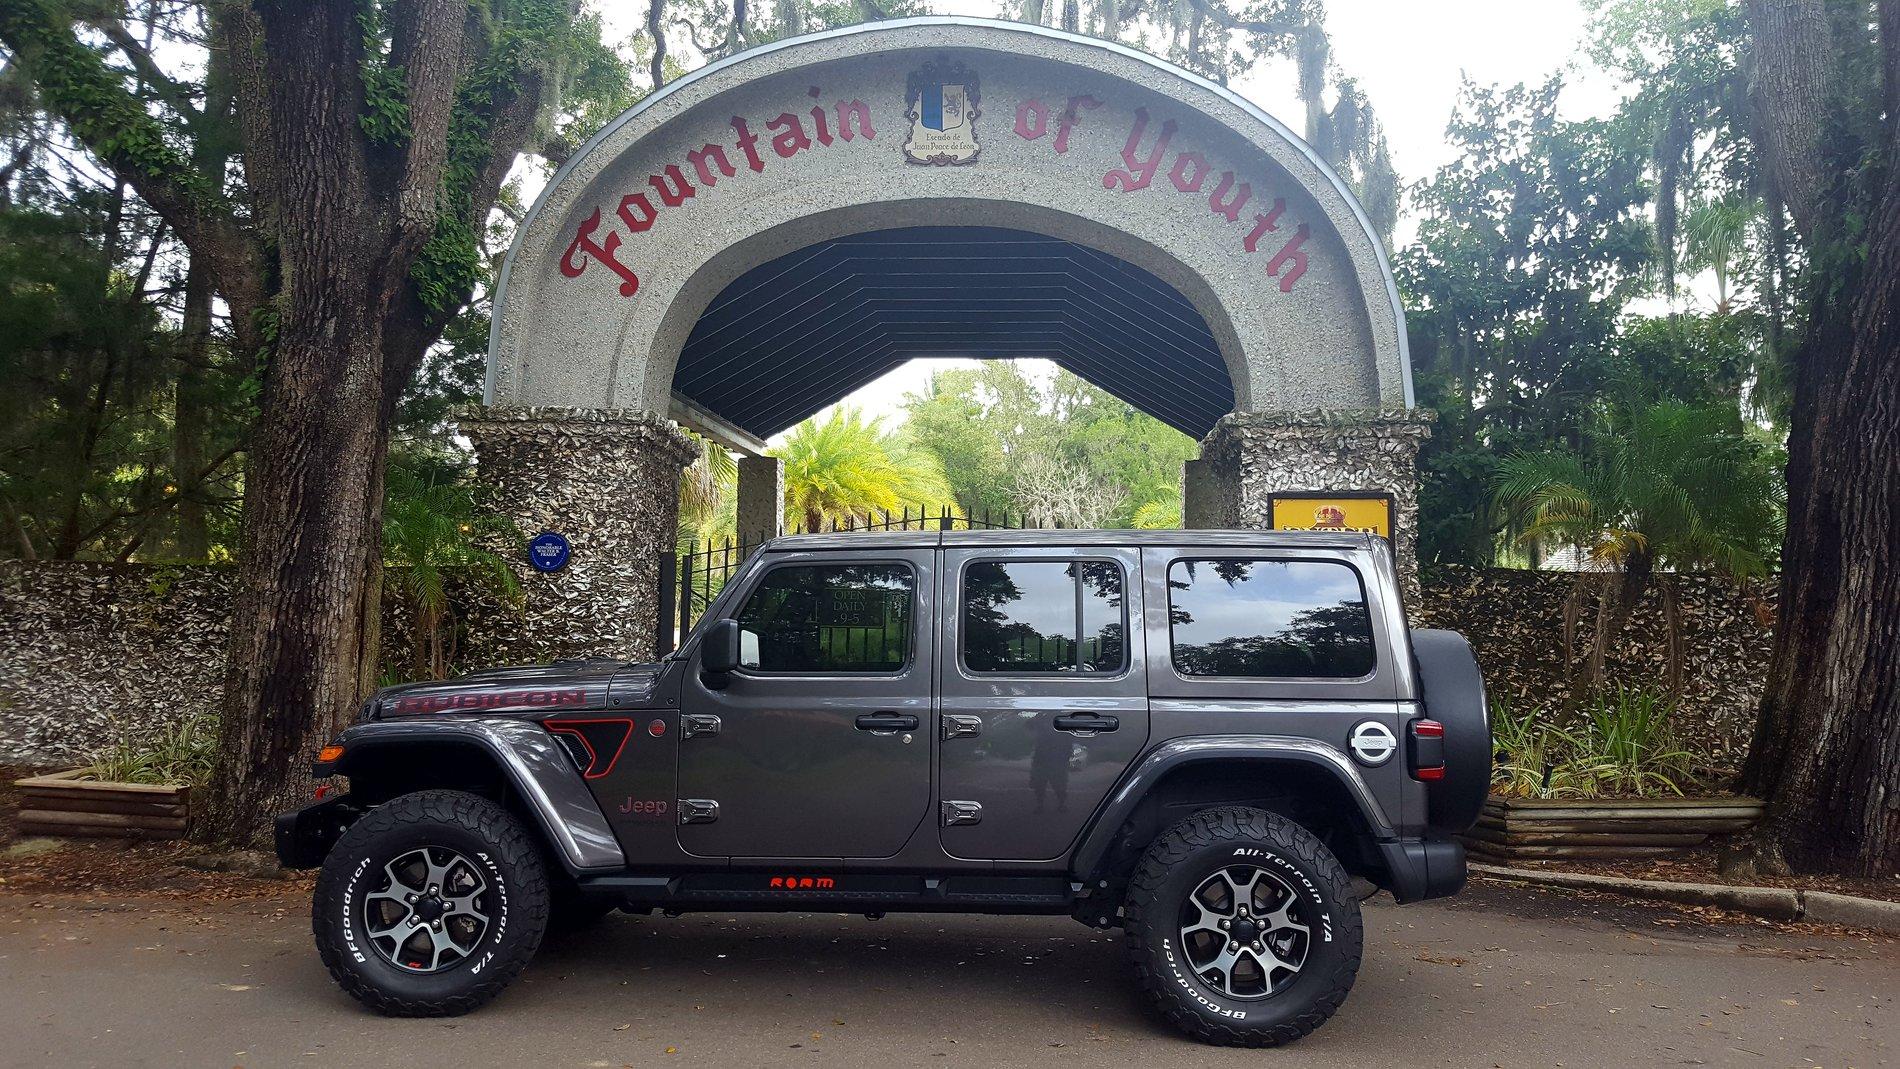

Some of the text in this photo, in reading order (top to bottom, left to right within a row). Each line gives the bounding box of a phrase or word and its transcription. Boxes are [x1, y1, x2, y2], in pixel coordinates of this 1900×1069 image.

[950, 142, 959, 150] de
[560, 86, 1310, 298] Fountain of Youth
[833, 602, 866, 611] DAILY
[834, 591, 866, 600] OPEN
[840, 613, 861, 624] 9-5
[394, 689, 588, 715] RUBICON
[1363, 738, 1383, 747] Jeep
[618, 796, 668, 816] Jeep
[1233, 848, 1333, 942] All-Terrain T/A
[343, 857, 371, 963] BFGoodrich
[471, 852, 508, 974] All-Terrain T/A
[1163, 938, 1247, 1020] BFGoodrich
